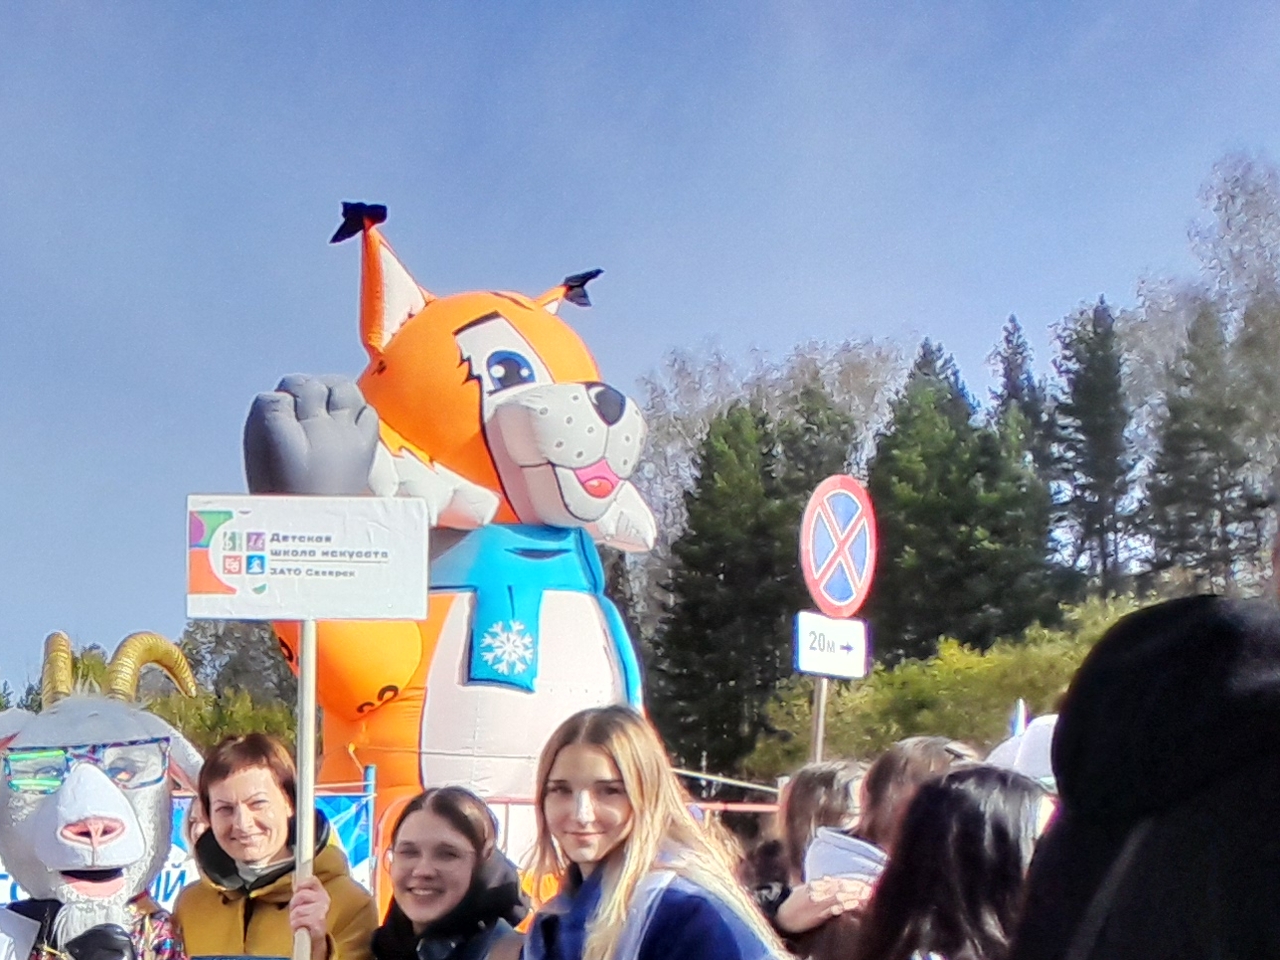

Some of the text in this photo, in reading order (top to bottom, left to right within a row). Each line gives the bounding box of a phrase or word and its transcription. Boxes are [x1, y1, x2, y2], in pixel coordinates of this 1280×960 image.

[271, 532, 333, 543] Детская
[270, 549, 316, 558] школа
[270, 567, 302, 576] ЗАТО
